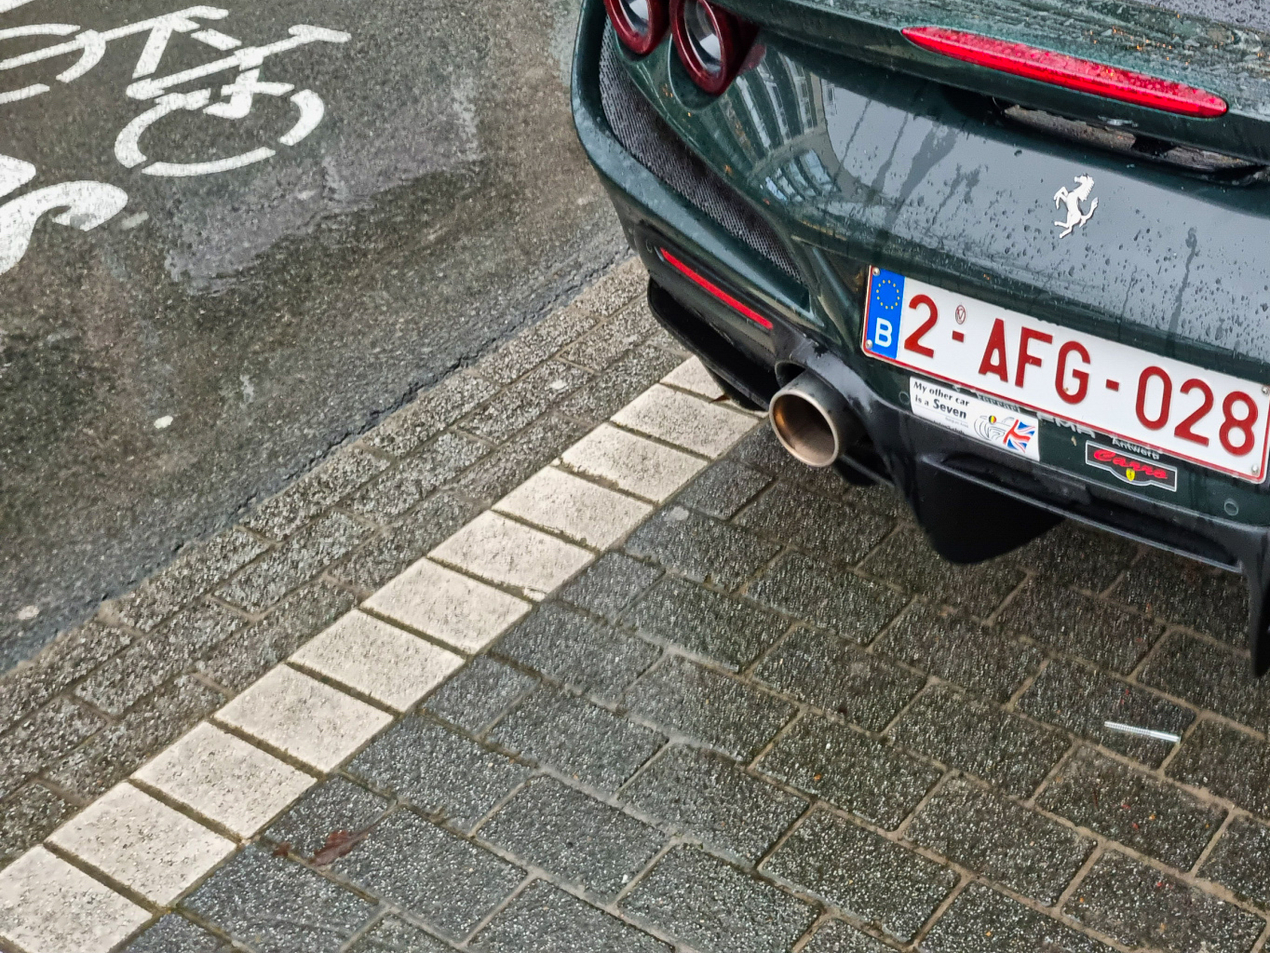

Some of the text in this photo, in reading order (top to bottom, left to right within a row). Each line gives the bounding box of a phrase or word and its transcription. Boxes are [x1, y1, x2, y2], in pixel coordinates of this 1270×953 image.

[874, 293, 1259, 456] B 2-AFG-028
[913, 382, 927, 393] My
[929, 388, 953, 400] other
[955, 398, 969, 407] car
[915, 394, 922, 404] is
[933, 399, 967, 419] Seven
